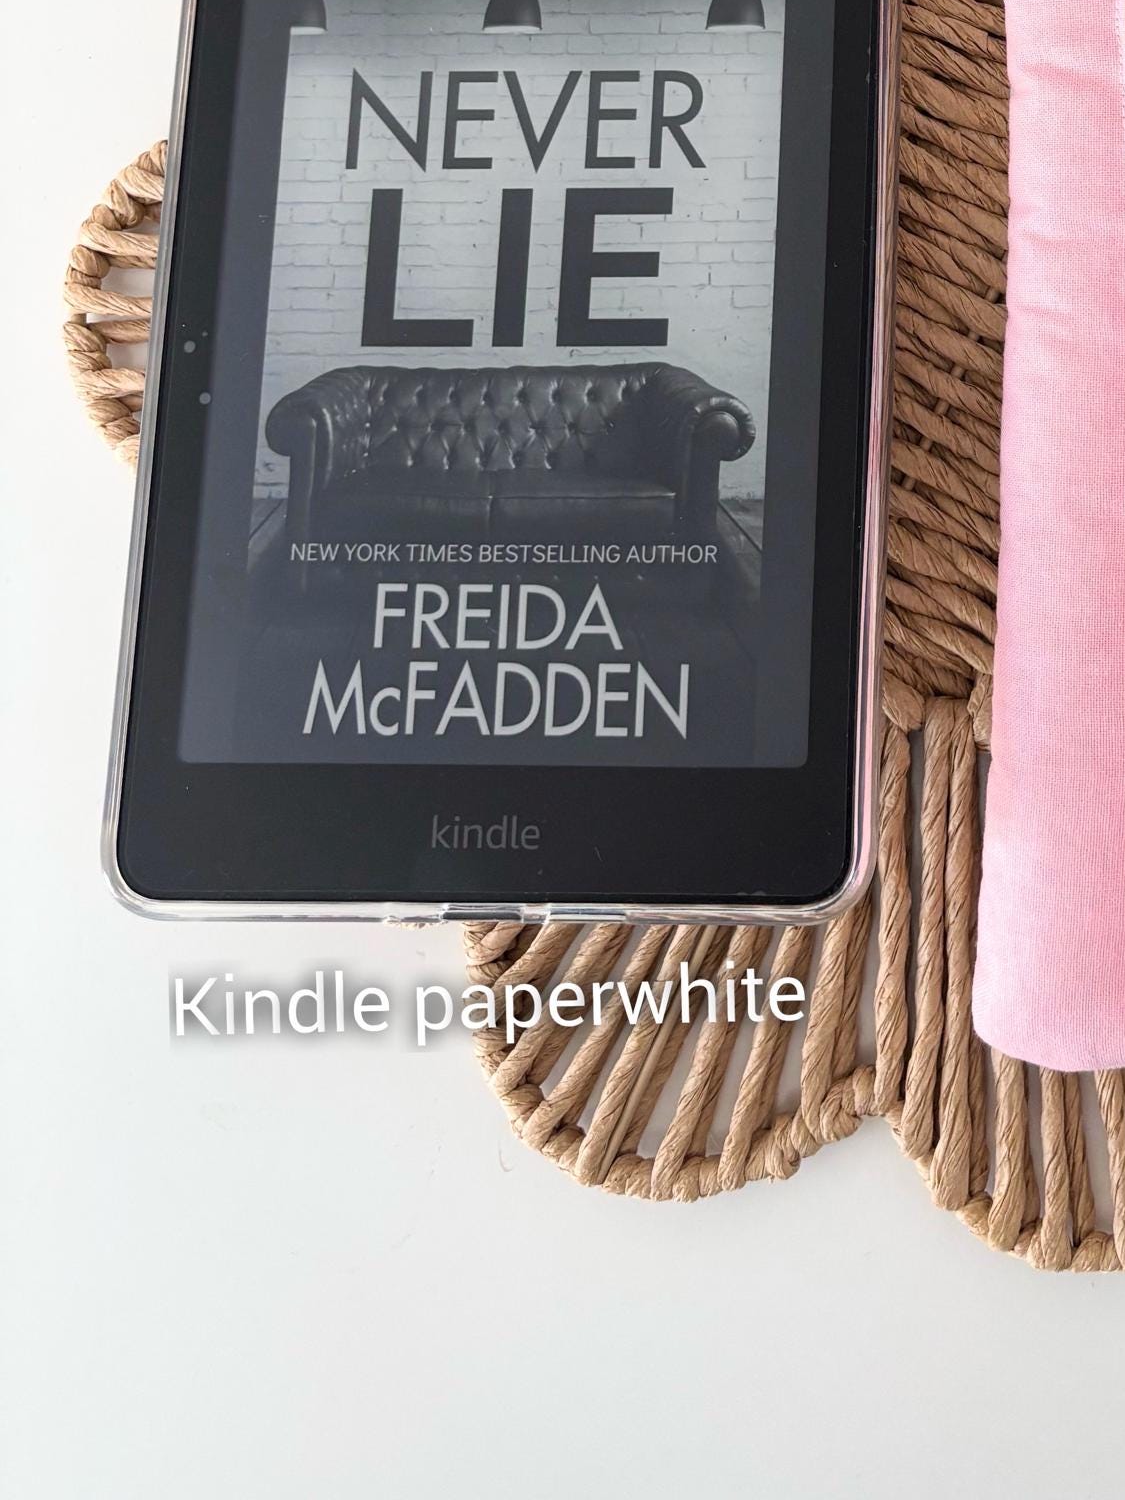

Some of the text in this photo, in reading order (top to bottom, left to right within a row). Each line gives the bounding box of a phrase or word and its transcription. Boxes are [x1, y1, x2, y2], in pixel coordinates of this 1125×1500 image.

[345, 68, 707, 173] NEVER
[360, 186, 674, 348] LIE
[290, 542, 719, 564] NEW YORK TIMES BESTSELLING AUTHOR
[373, 582, 624, 651] FREIDA
[302, 659, 690, 740] McFADDEN
[430, 815, 541, 851] kindle
